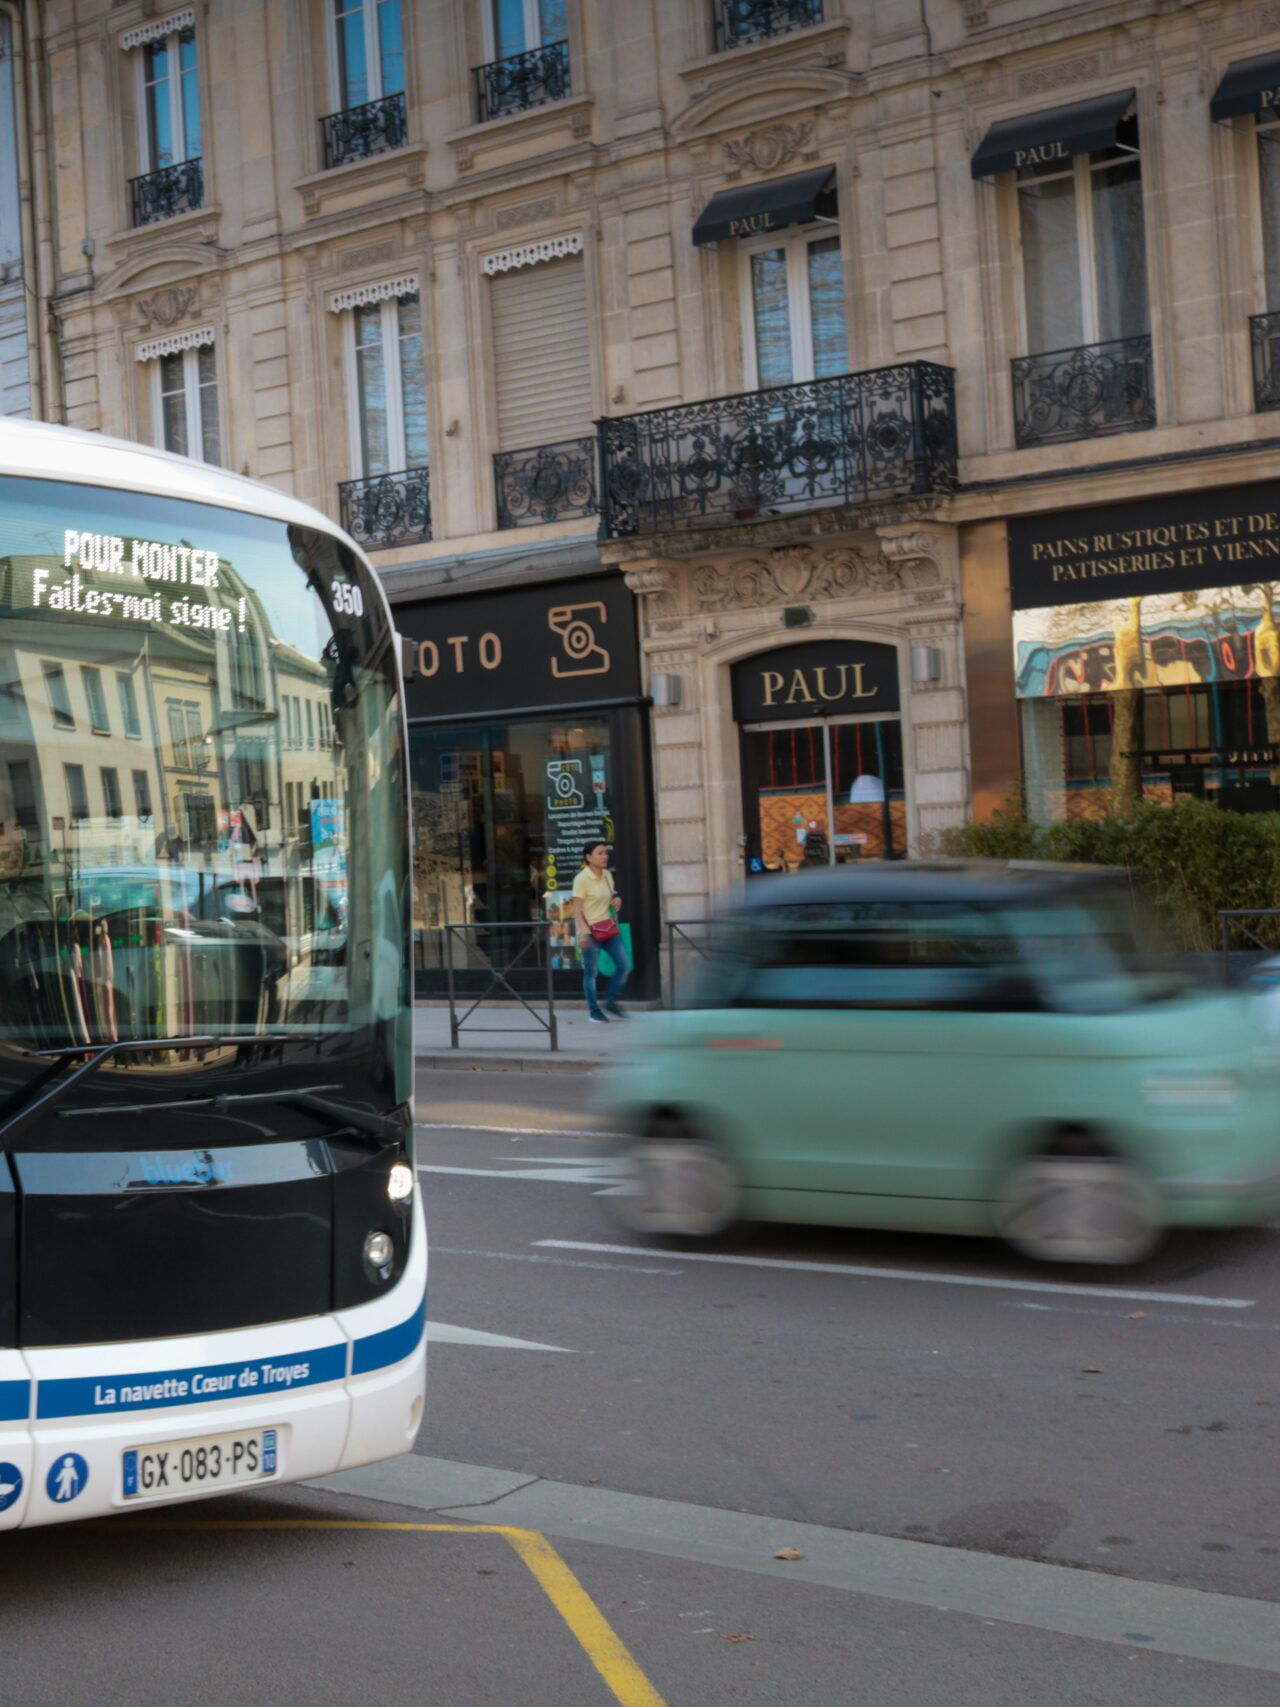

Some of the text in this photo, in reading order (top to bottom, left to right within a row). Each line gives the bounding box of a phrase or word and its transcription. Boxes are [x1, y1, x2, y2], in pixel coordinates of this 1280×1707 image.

[1015, 141, 1069, 167] PAUL
[729, 212, 775, 236] PAUL
[64, 529, 219, 588] POUR MONTER
[1032, 537, 1089, 560] PAINS
[1093, 522, 1210, 552] RUSTIQUES
[1214, 517, 1244, 537] ET
[1052, 551, 1175, 582] PATISSERIES
[1180, 546, 1209, 567] ET
[32, 568, 163, 622] Faites-moi
[169, 595, 233, 631] signe
[331, 580, 364, 617] 350
[760, 663, 879, 706] PAUL
[553, 797, 579, 806] PHOTO
[94, 1362, 310, 1405] La navette Cœur de Troyes
[141, 1439, 258, 1489] GX-083-PS
